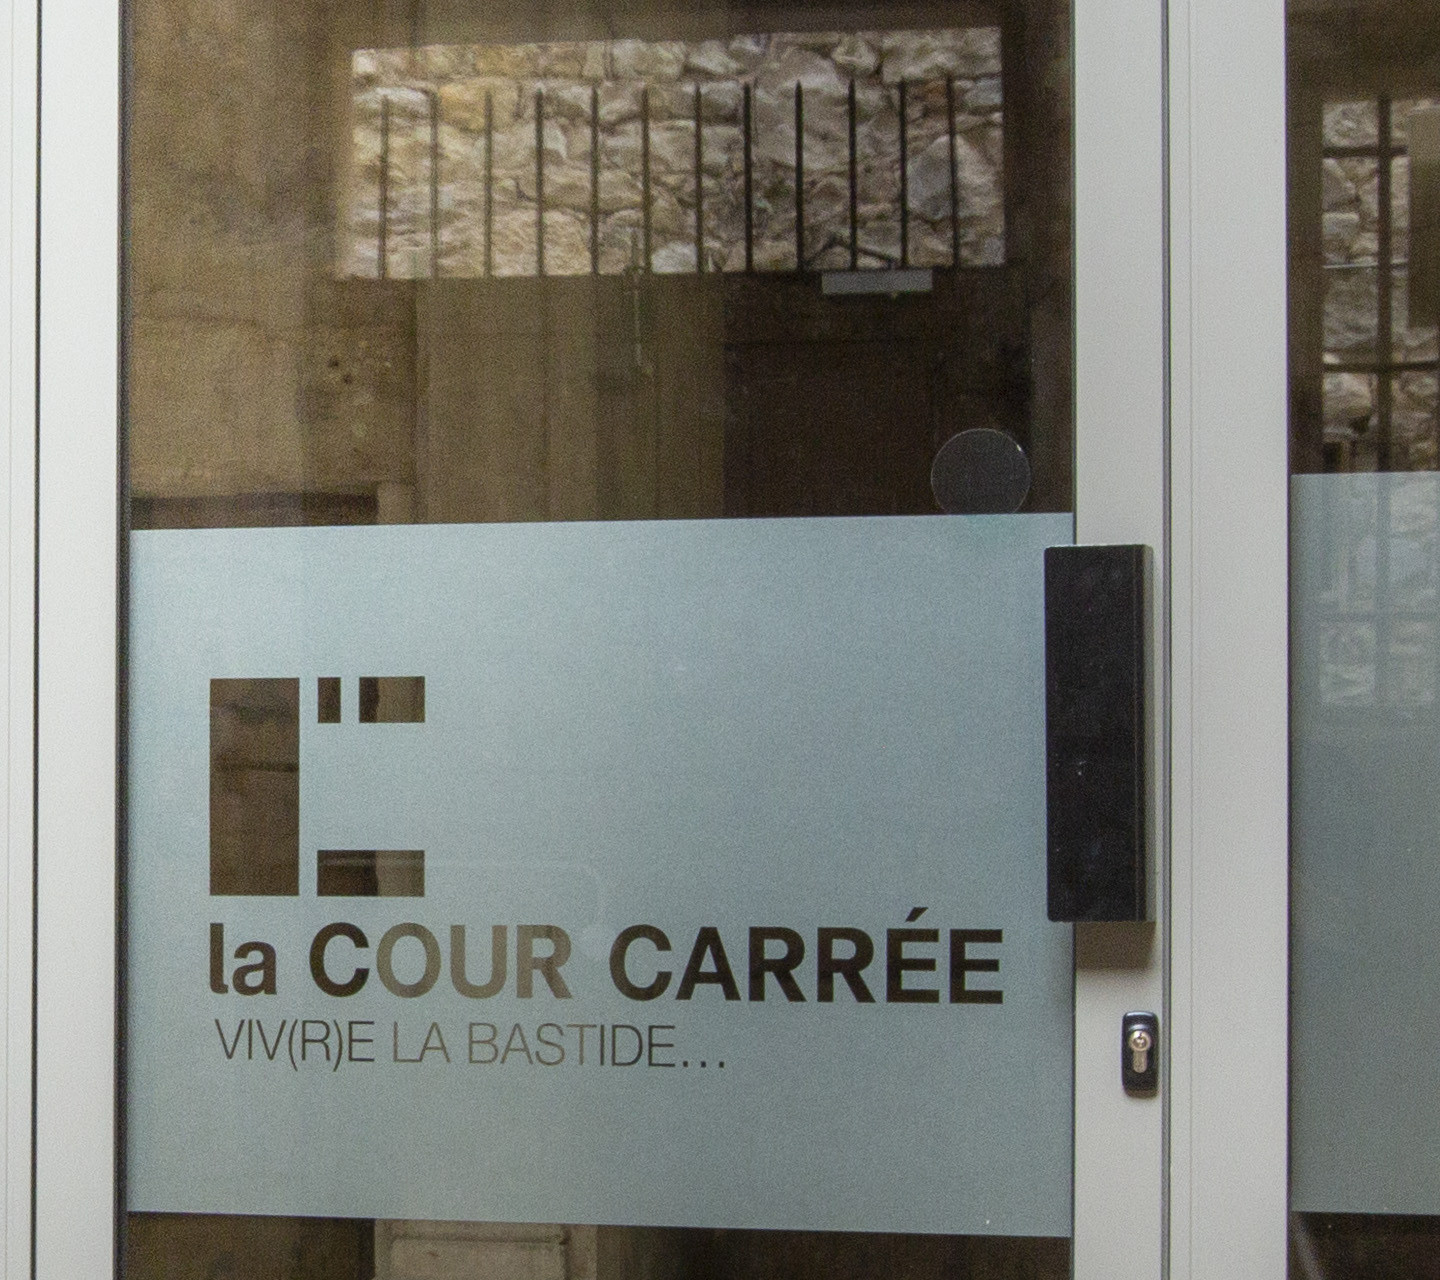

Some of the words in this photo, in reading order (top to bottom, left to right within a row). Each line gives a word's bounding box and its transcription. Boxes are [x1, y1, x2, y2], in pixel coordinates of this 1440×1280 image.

[208, 922, 278, 996] la
[308, 922, 573, 1000] COUR
[608, 906, 1005, 1005] CARRÉE
[214, 1018, 376, 1072] VIV(R)E
[392, 1020, 451, 1064] LA
